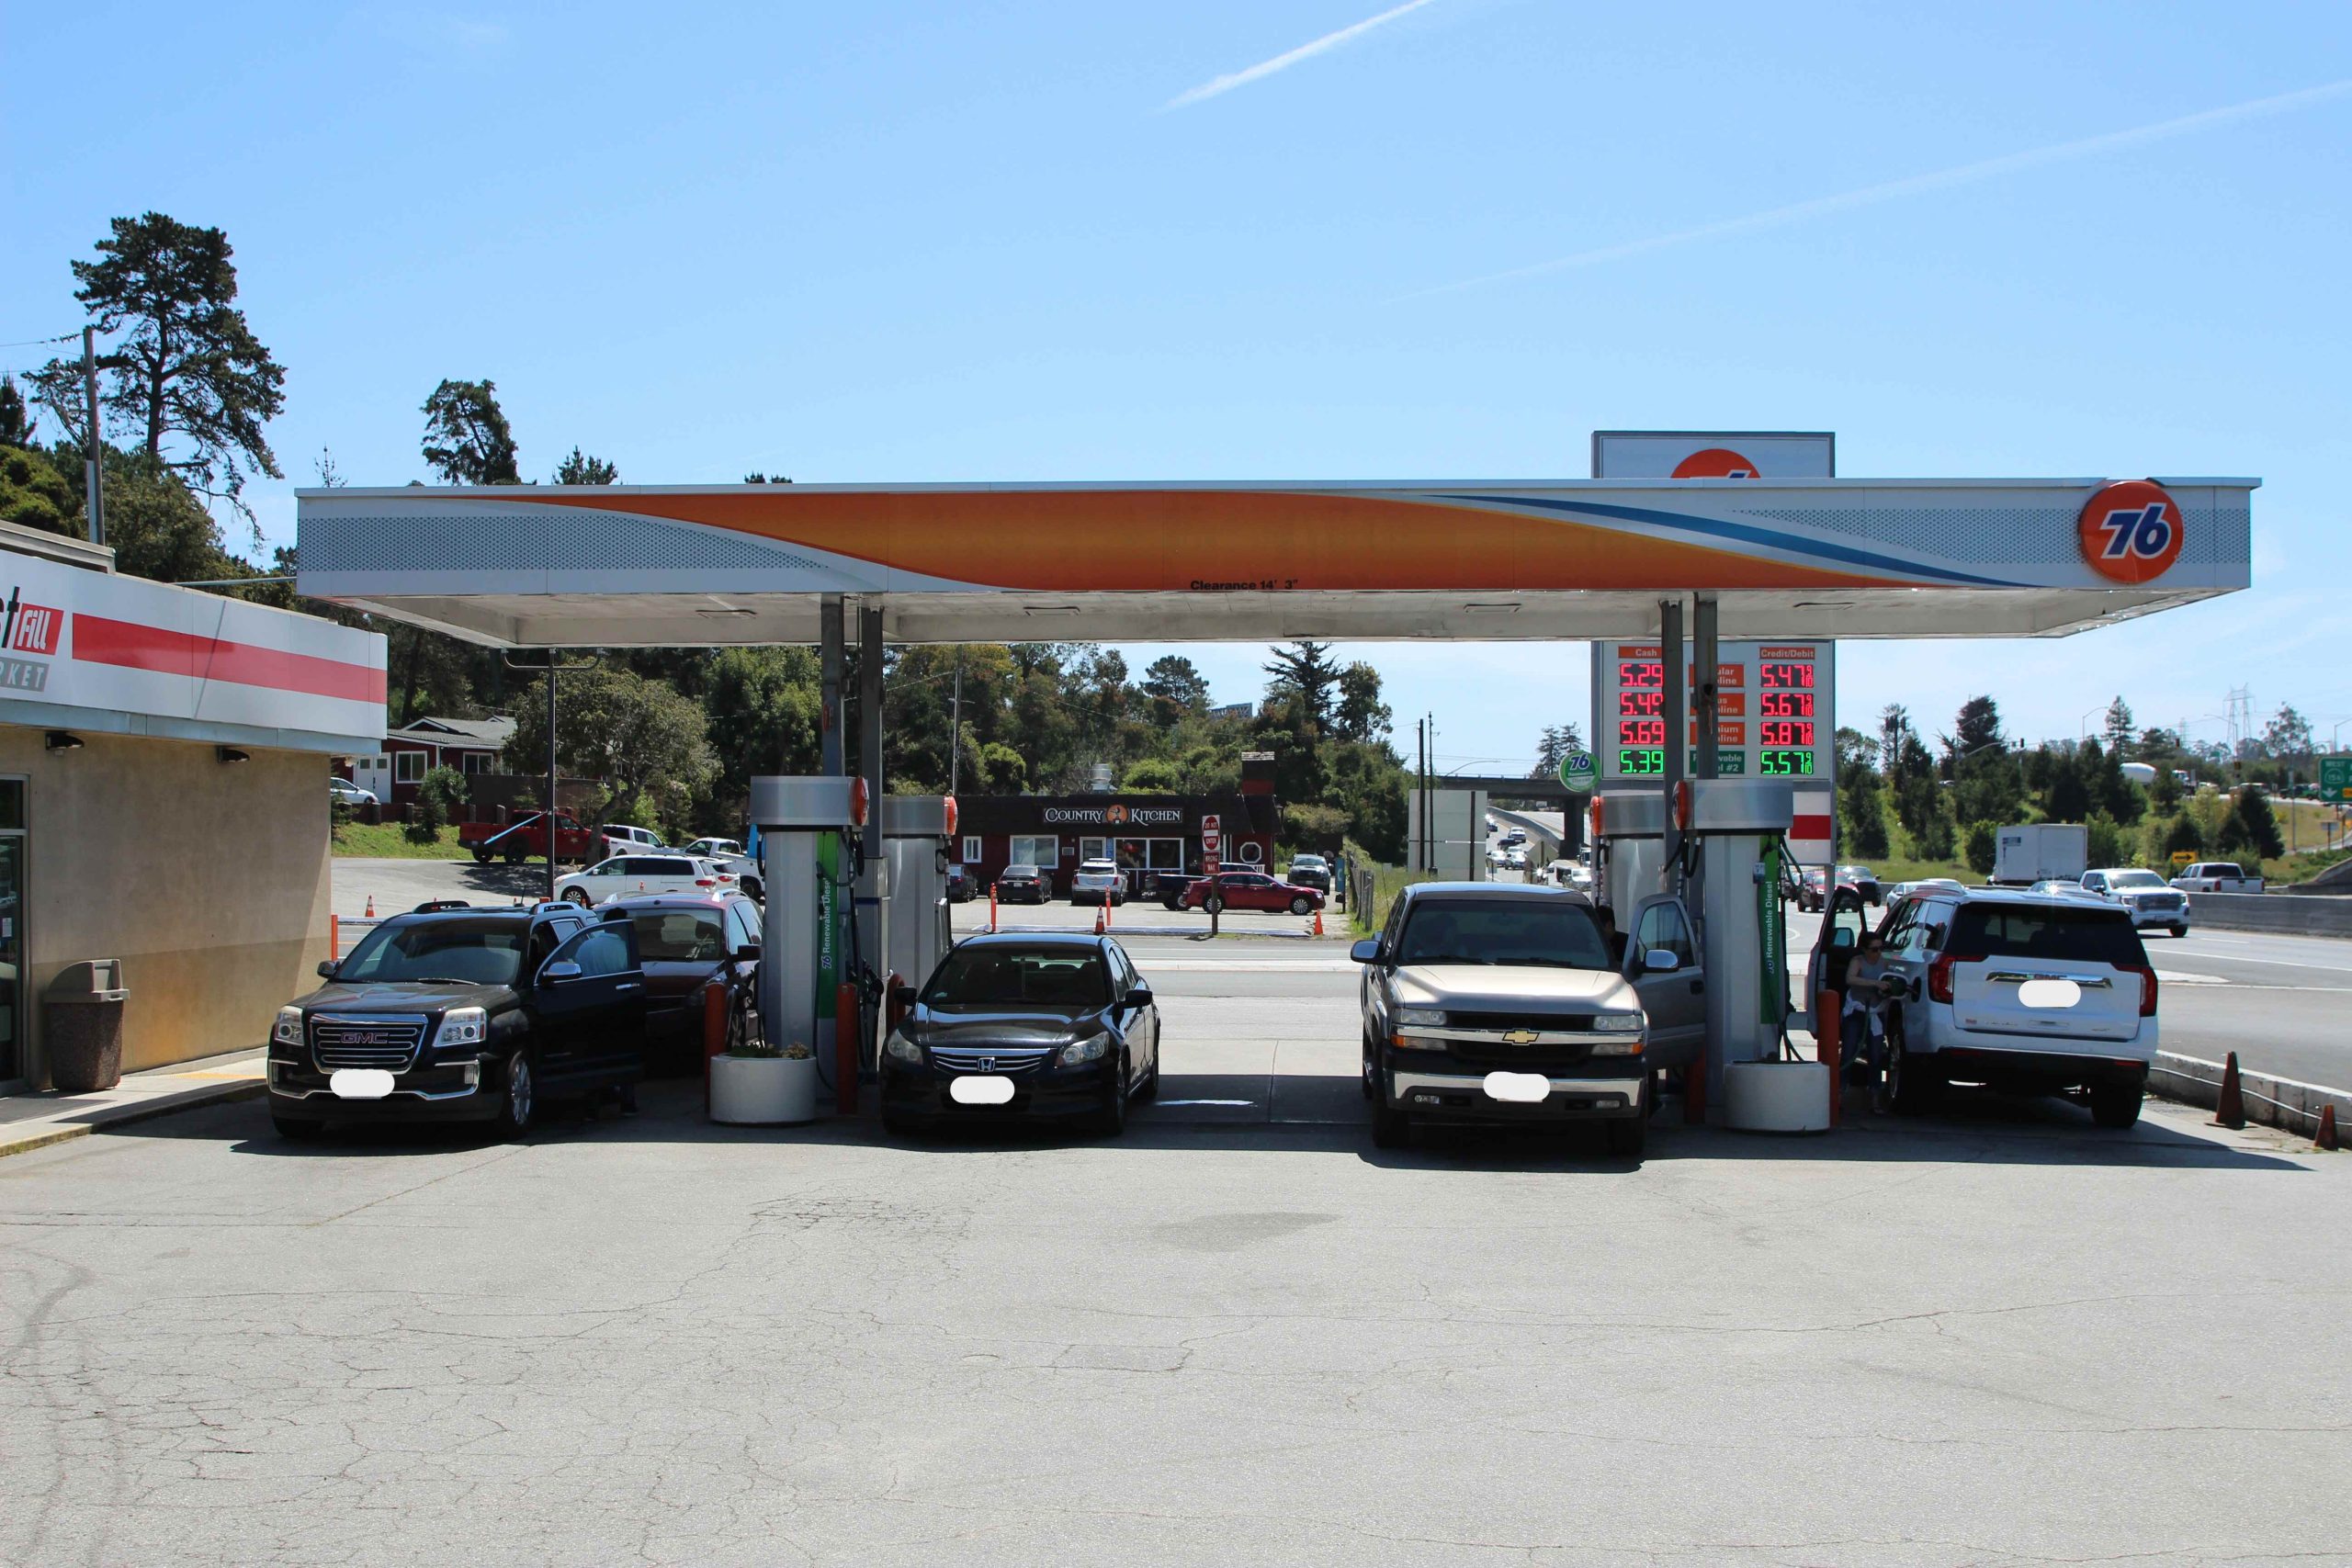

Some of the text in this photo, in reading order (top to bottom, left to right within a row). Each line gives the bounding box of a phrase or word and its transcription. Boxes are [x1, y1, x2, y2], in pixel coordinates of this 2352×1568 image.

[2099, 502, 2172, 559] 76
[1190, 580, 1257, 590] Clearance
[1260, 579, 1278, 590] 14'
[1635, 649, 1657, 657] Cash
[1760, 649, 1815, 658] Credit/Debit
[1621, 663, 1664, 686] 5.29
[1621, 721, 1664, 744] 5.69
[1569, 753, 1590, 770] 76
[1621, 750, 1664, 773] 5.39
[1725, 763, 1739, 773] #2
[1765, 881, 1773, 908] Diesel
[822, 907, 831, 953] Renewable
[1765, 910, 1773, 958] Renewable
[821, 955, 831, 969] 76
[341, 1032, 388, 1043] GMC
